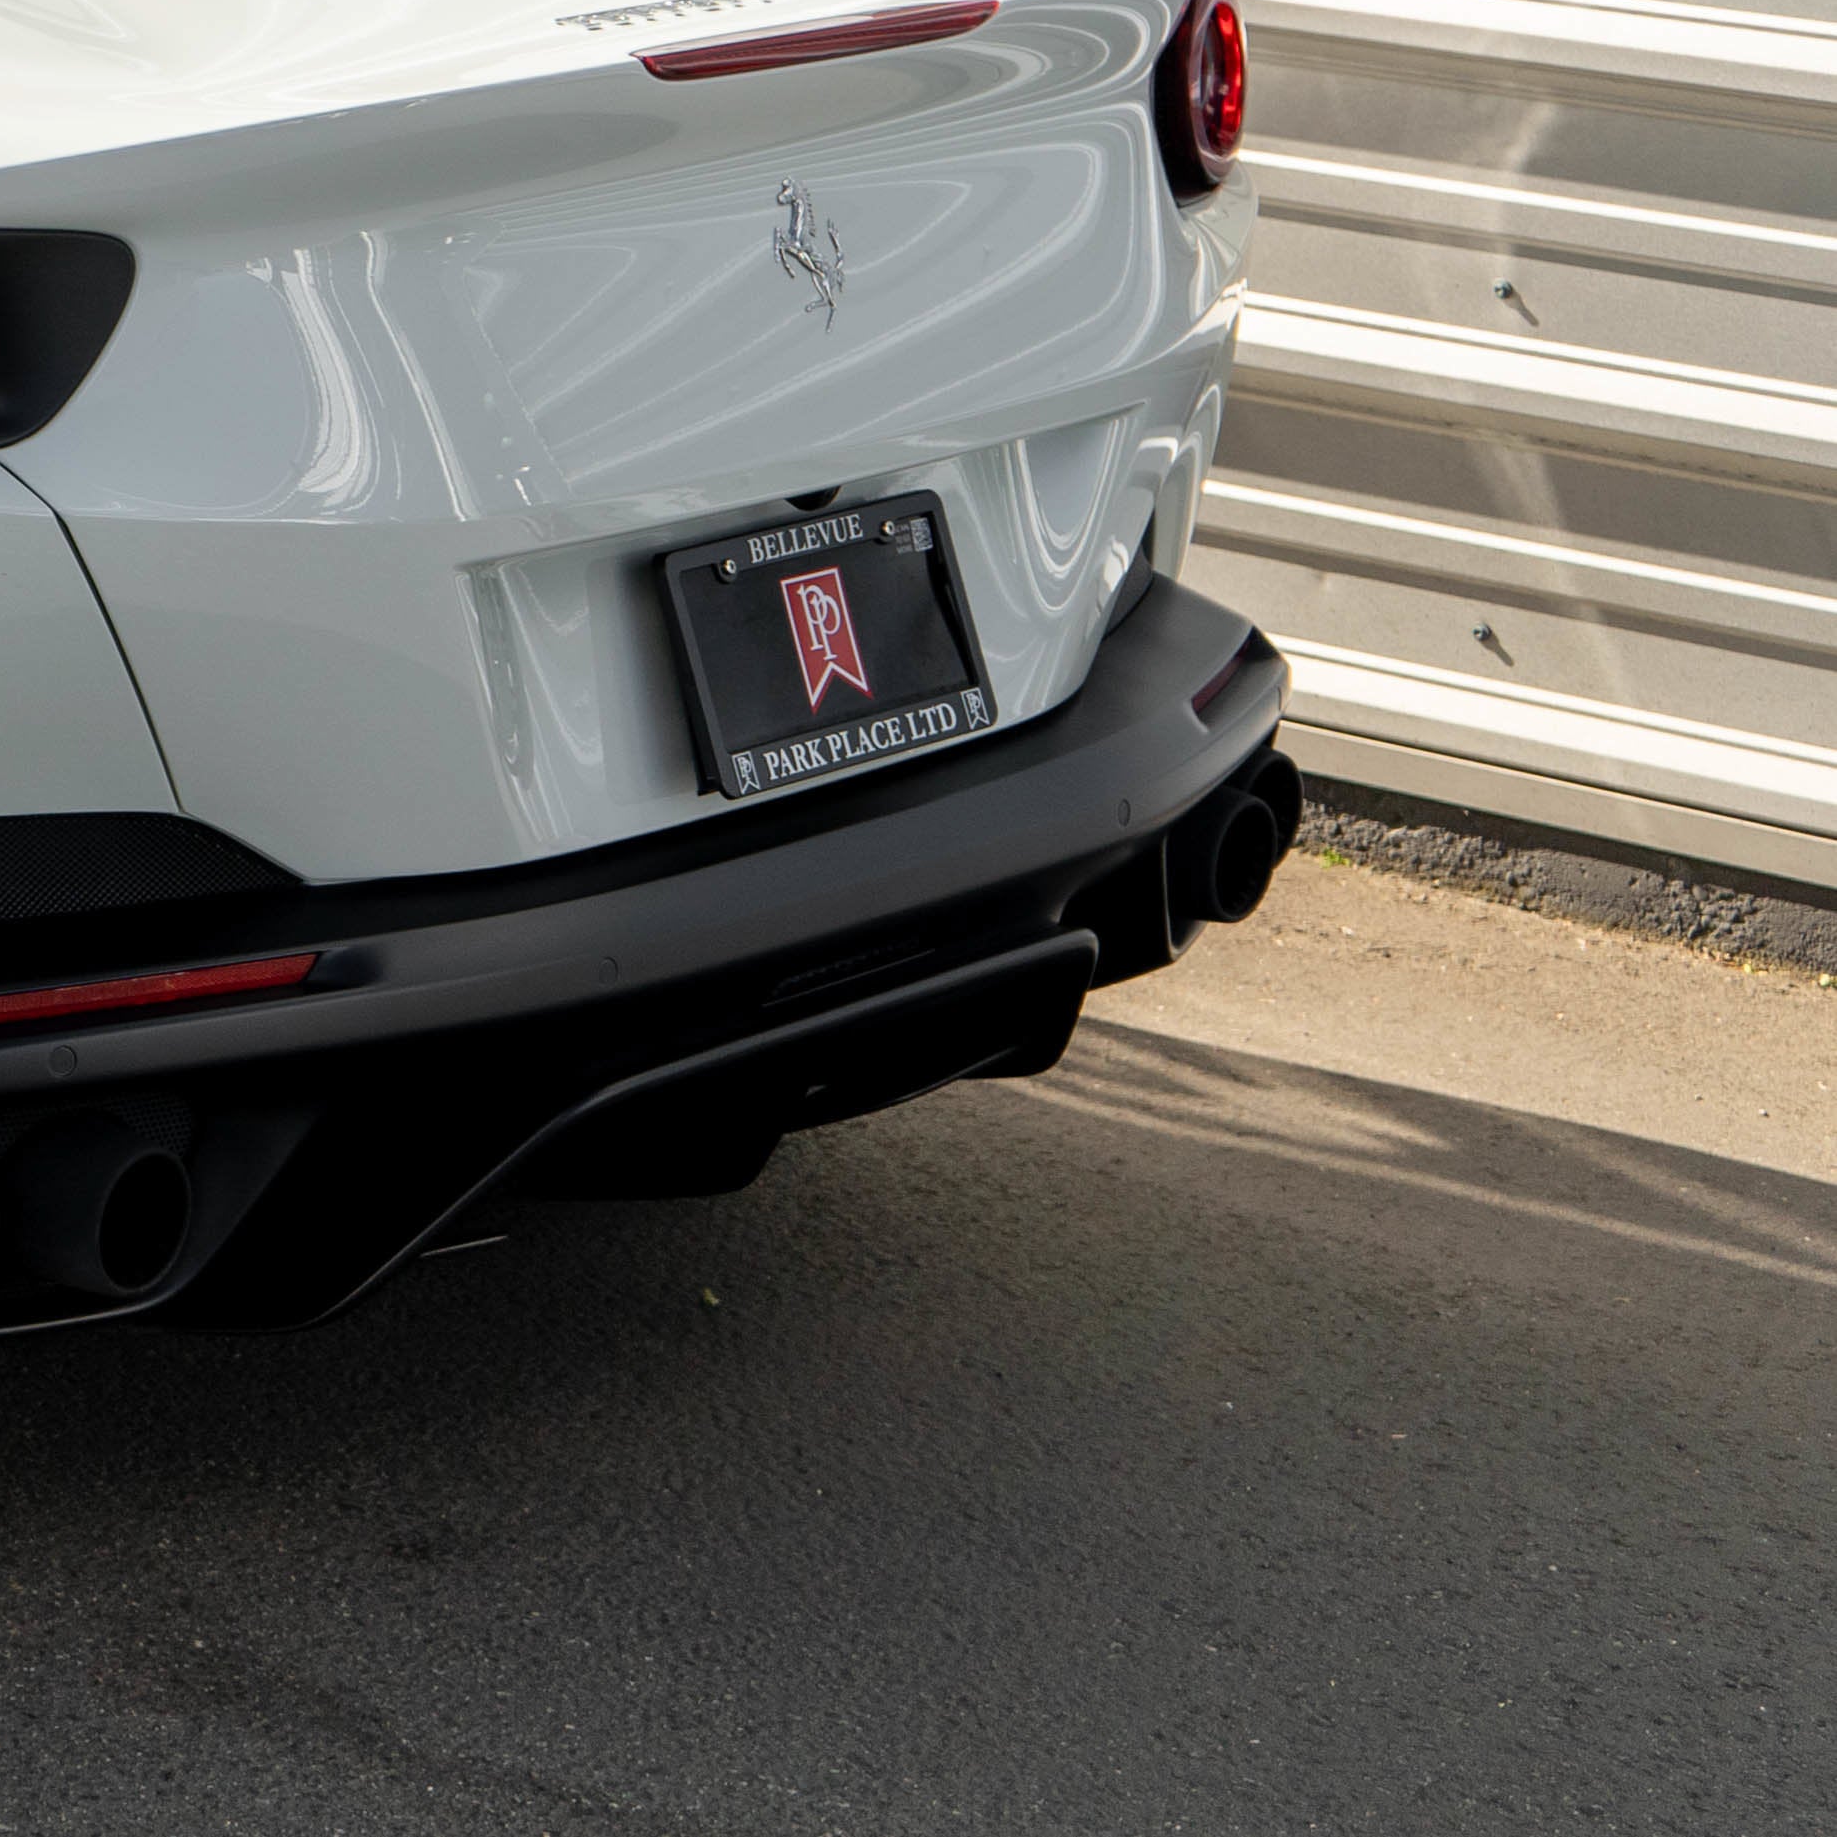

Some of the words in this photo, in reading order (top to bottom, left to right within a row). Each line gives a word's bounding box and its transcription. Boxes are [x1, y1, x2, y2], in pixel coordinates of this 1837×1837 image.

[747, 514, 863, 564] BELLEVUE
[763, 739, 828, 780] PARK
[826, 717, 905, 762] PLACE
[905, 703, 957, 740] LTD
